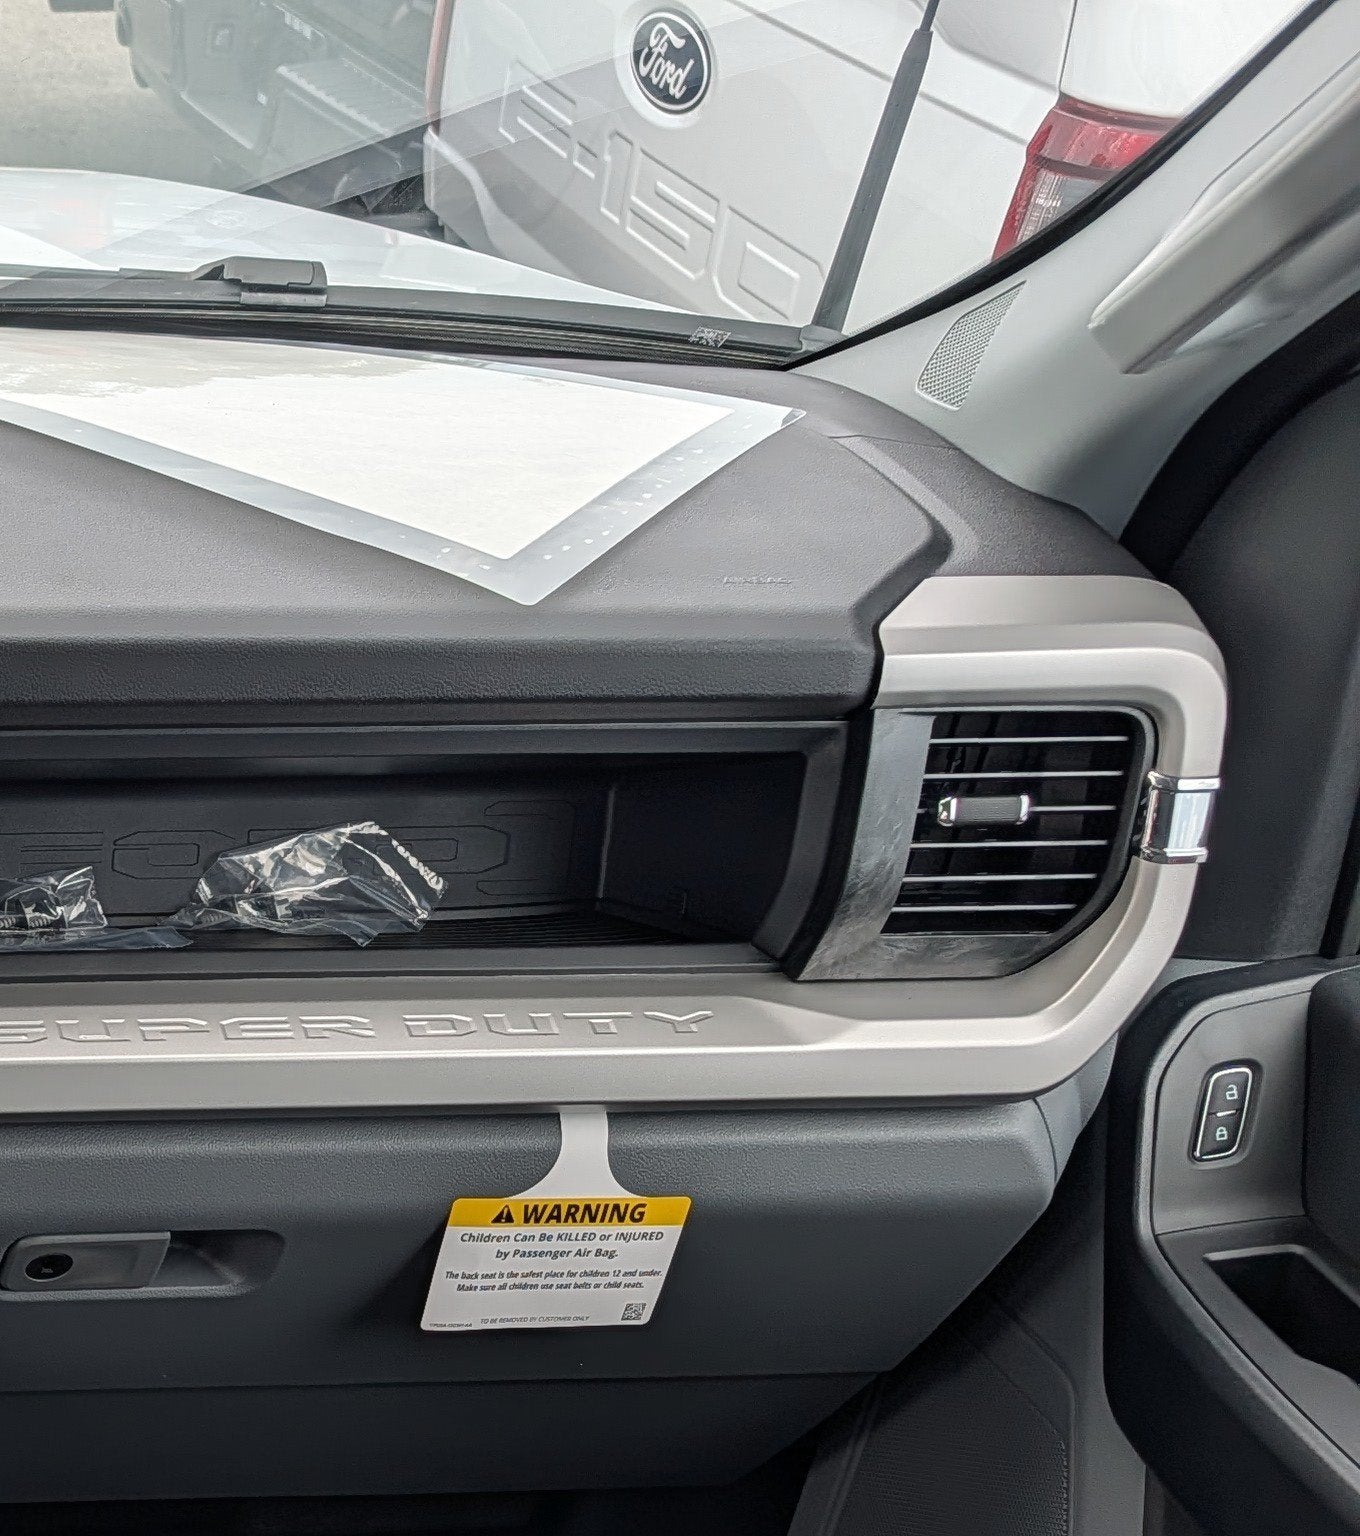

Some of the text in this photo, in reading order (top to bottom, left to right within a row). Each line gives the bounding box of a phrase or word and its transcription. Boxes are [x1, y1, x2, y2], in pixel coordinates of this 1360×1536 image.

[638, 22, 694, 99] Ford
[403, 1010, 714, 1040] DUTY
[522, 1203, 648, 1224] WARNING
[460, 1231, 664, 1243] Children Can Be KILLED or INJURED
[495, 1248, 619, 1260] by Passenger Air Bag.
[446, 1271, 459, 1279] The
[461, 1271, 479, 1279] back
[481, 1271, 496, 1279] seat
[499, 1271, 505, 1279] is
[507, 1271, 518, 1279] the
[520, 1270, 542, 1279] safest
[544, 1270, 564, 1280] place
[566, 1270, 577, 1279] for
[579, 1269, 610, 1278] children
[612, 1269, 621, 1278] 12
[622, 1269, 638, 1278] and
[456, 1284, 478, 1292] Make
[497, 1283, 508, 1291] all
[509, 1282, 539, 1290] children
[555, 1282, 572, 1290] seat
[573, 1281, 592, 1289] belts
[603, 1281, 622, 1289] child
